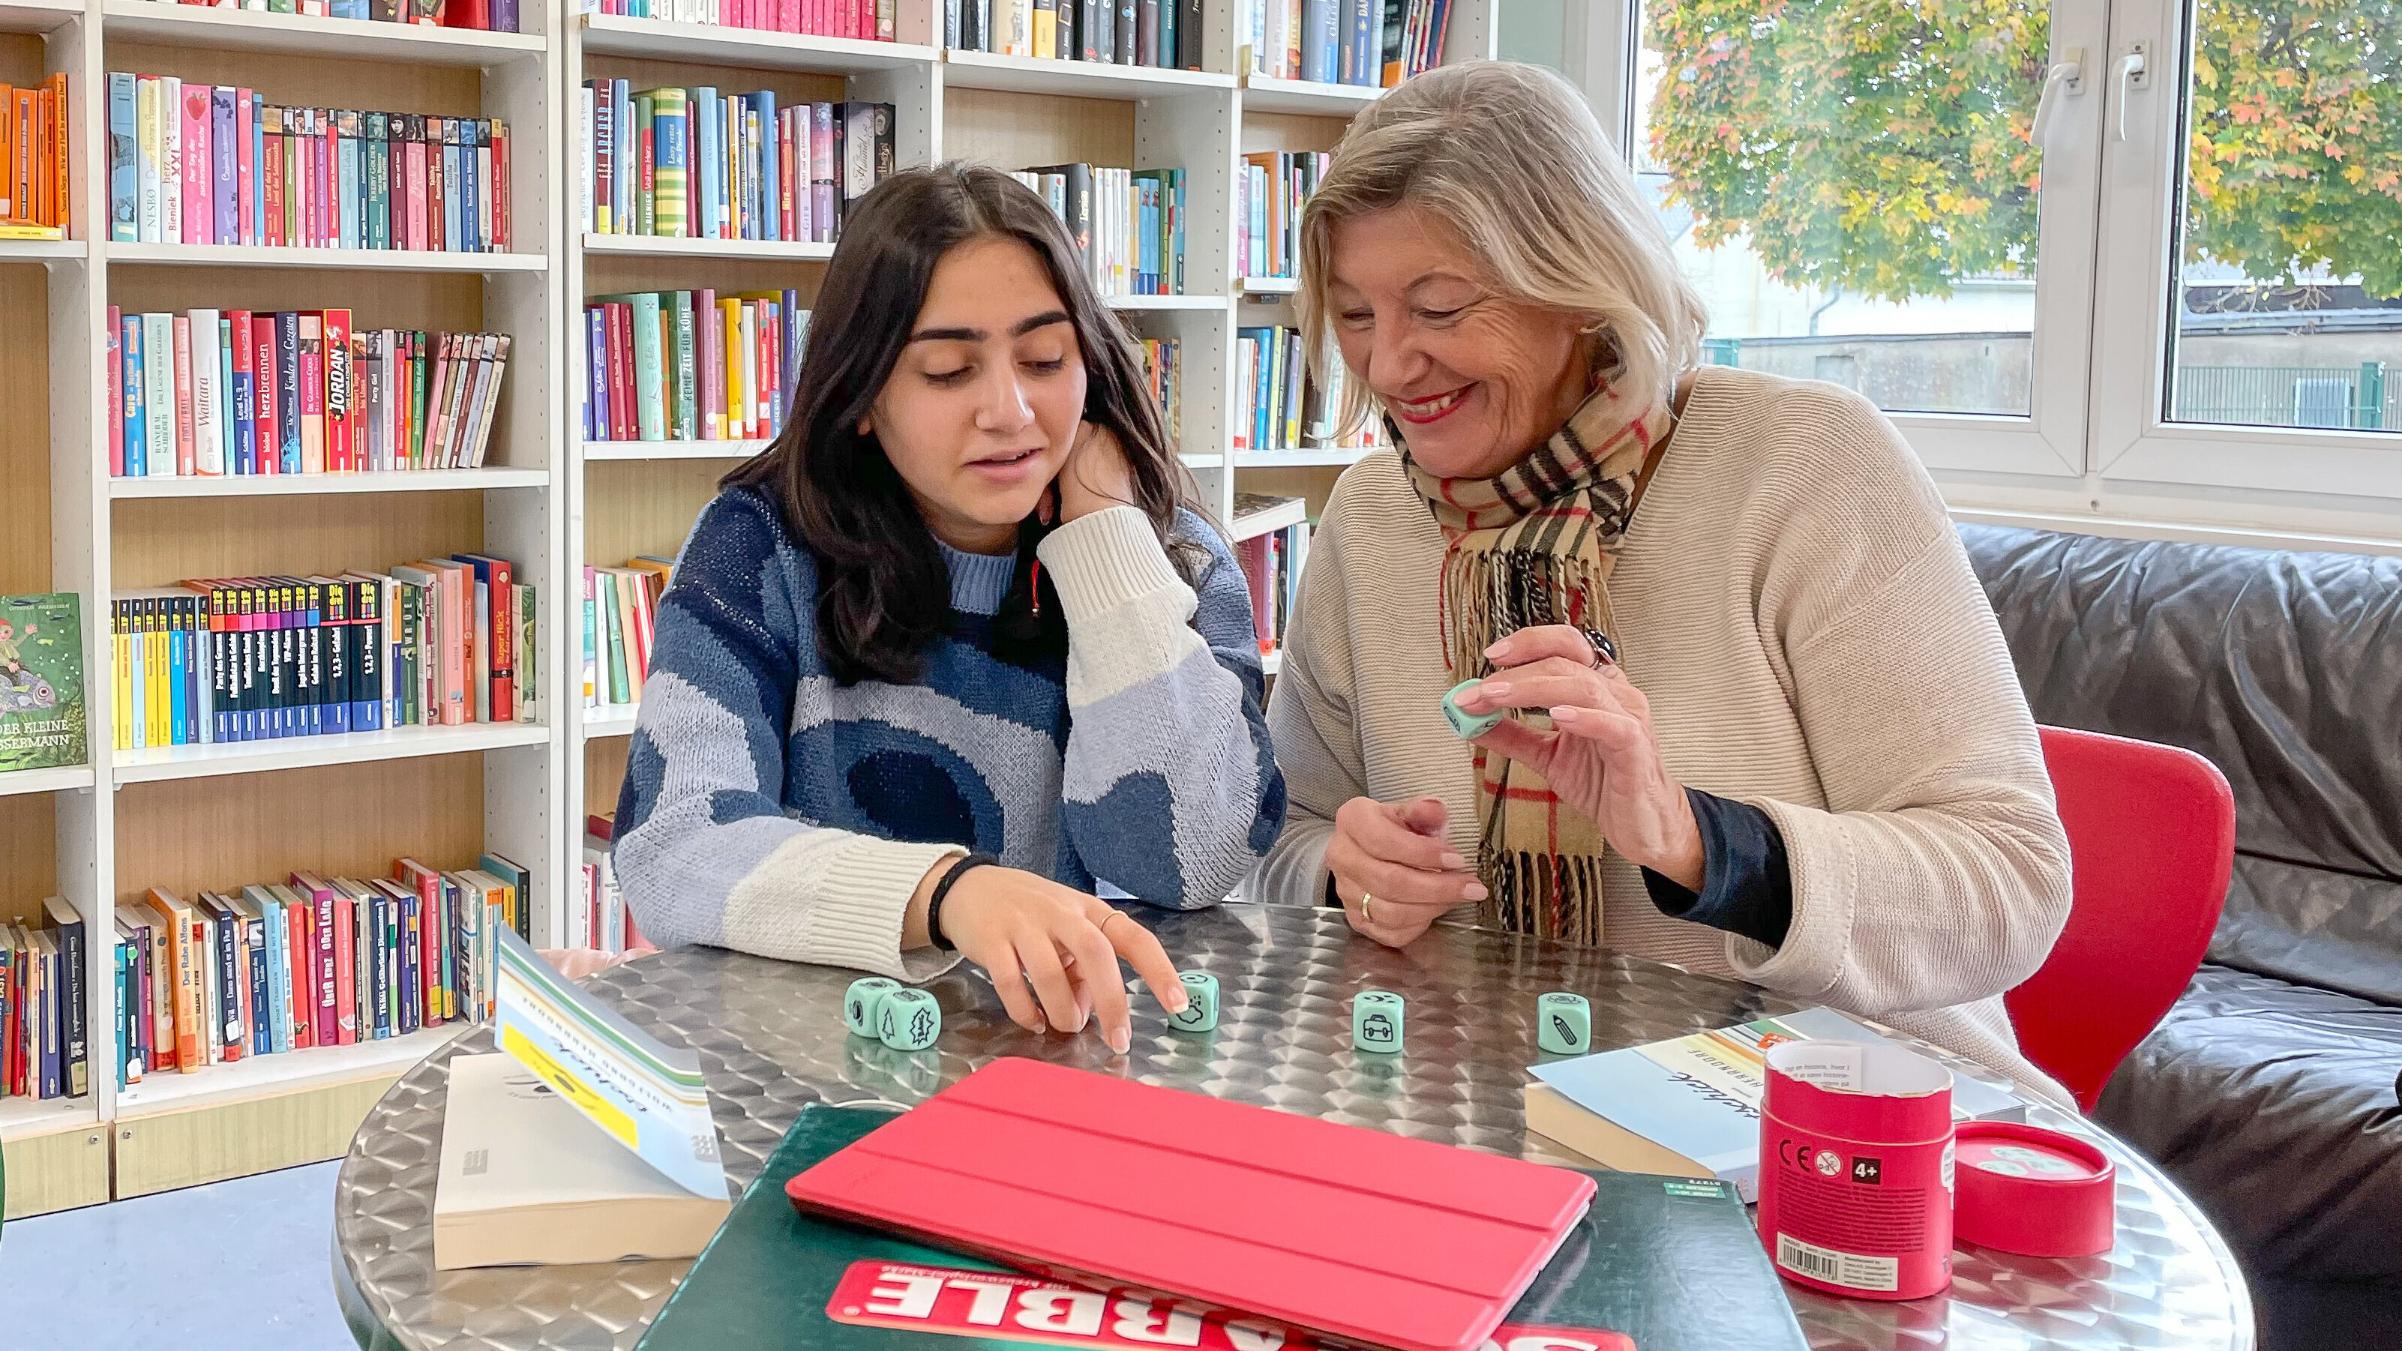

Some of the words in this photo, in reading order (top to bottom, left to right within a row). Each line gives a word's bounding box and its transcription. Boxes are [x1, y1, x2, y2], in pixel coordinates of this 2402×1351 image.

[162, 161, 172, 184] herz
[170, 146, 180, 177] XXL
[188, 168, 196, 183] Der
[146, 188, 158, 228] NESBØ
[168, 196, 178, 232] Bieniek
[679, 306, 691, 331] KÜHE
[681, 353, 692, 373] ZEIT
[258, 343, 271, 419] herzbrennen
[283, 364, 296, 392] Kinder
[328, 349, 345, 415] JORDAN
[370, 373, 378, 385] Girl
[197, 377, 210, 428] Waitara
[371, 386, 379, 403] Party
[496, 610, 504, 634] Nick
[496, 634, 505, 665] Super
[215, 672, 225, 690] Party
[24, 719, 69, 734] KLEINE
[318, 900, 333, 926] LANG
[180, 917, 189, 945] Alfons
[320, 927, 332, 950] ODER
[181, 946, 190, 968] Rabe
[182, 969, 190, 986] Der
[322, 981, 336, 1008] ÜBER
[1687, 1049, 1764, 1088] HERRNDORF
[1855, 1163, 1878, 1178] 4+
